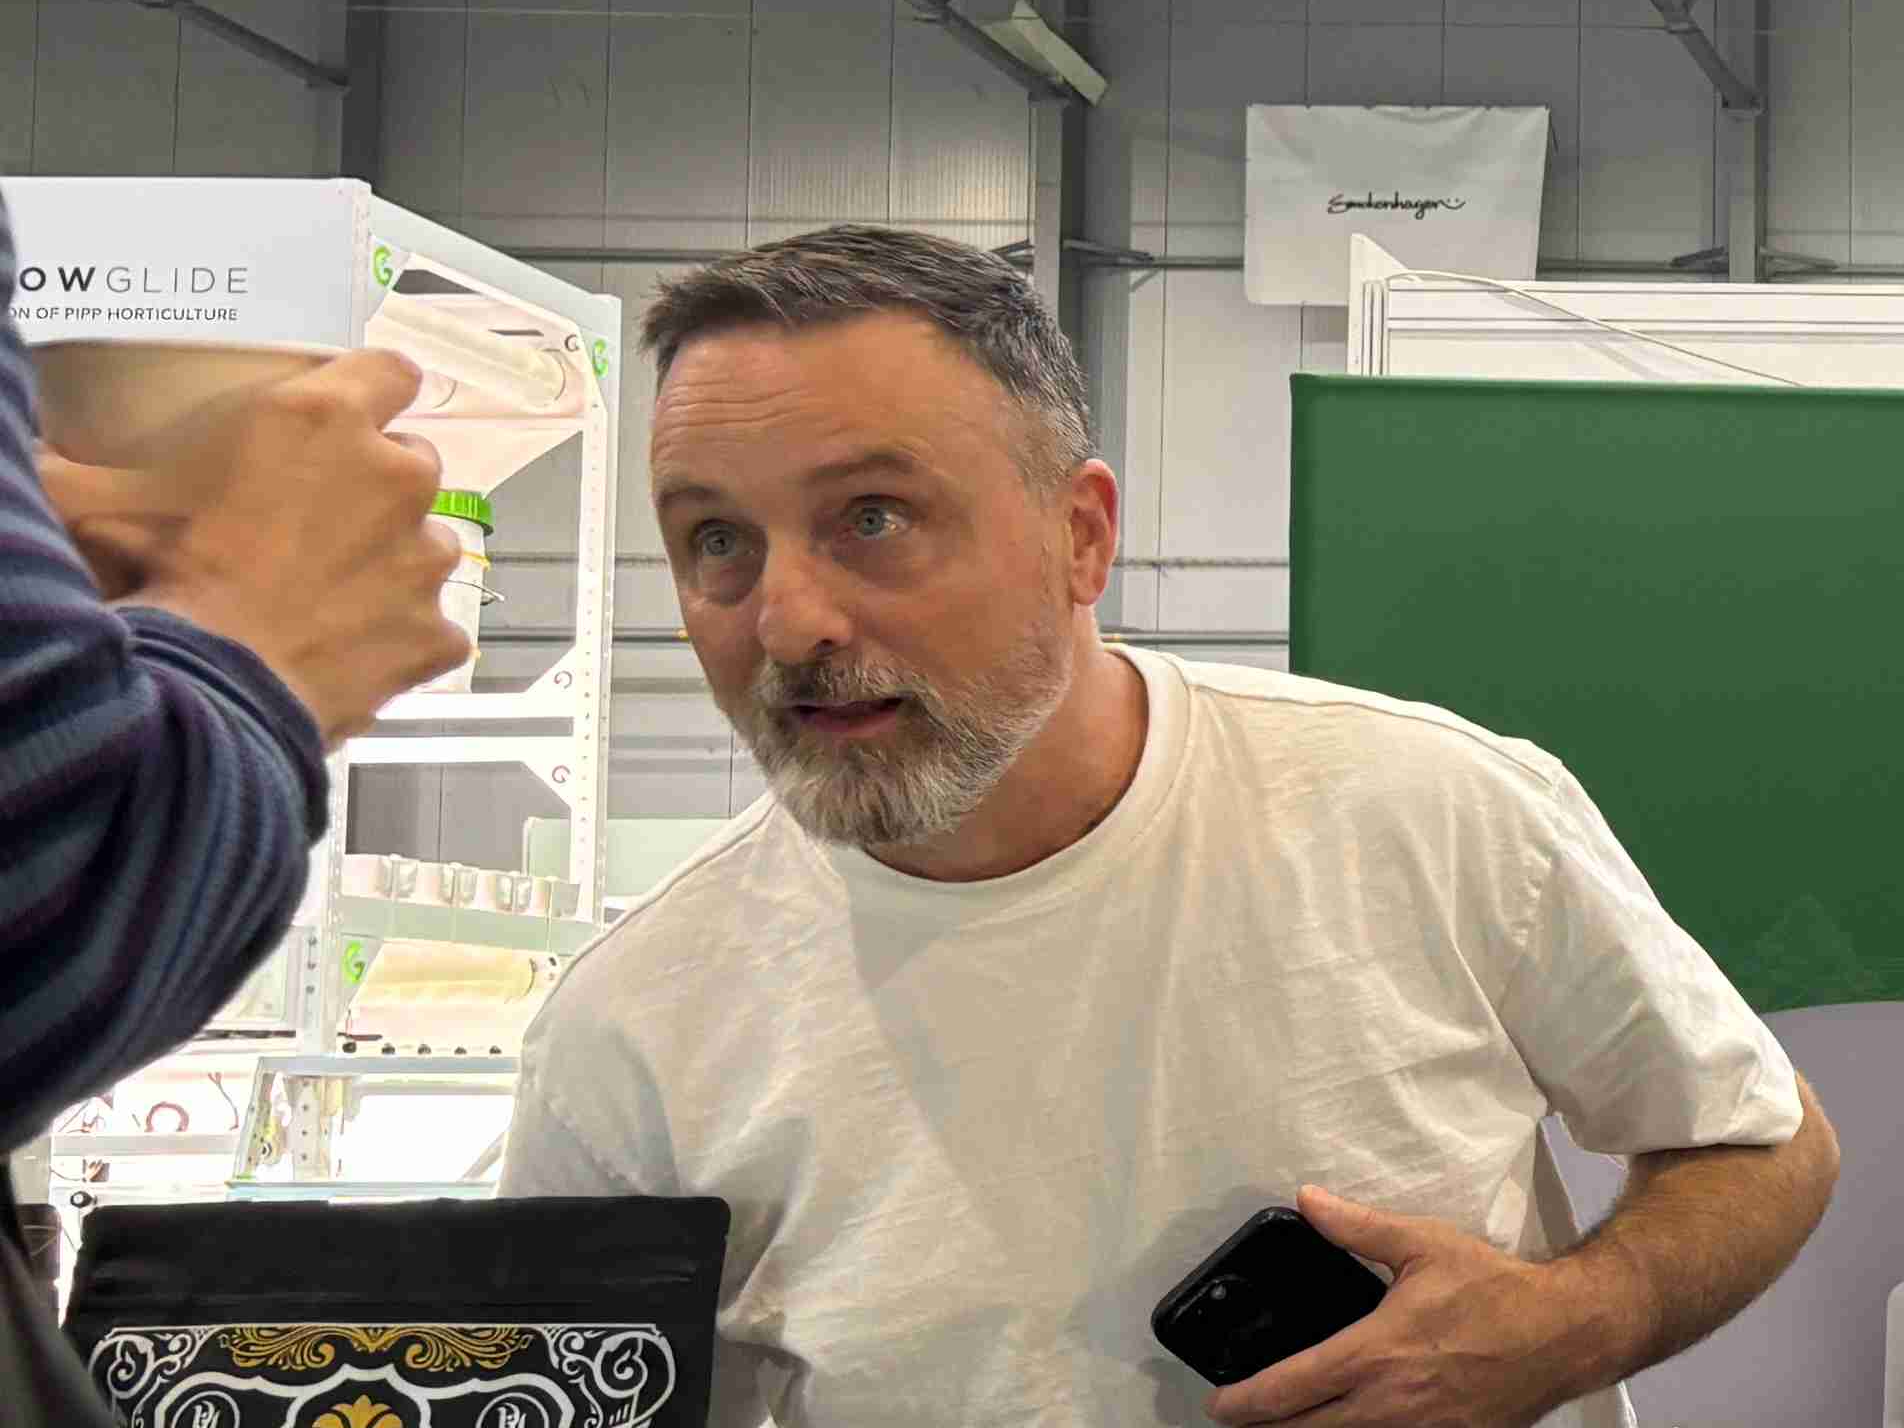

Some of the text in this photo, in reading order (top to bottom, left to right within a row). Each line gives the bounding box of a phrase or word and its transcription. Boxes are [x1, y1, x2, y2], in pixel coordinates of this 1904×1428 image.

[18, 264, 250, 296] OWGLIDE
[38, 306, 60, 321] OF
[65, 305, 102, 322] PIPP
[107, 305, 239, 322] HORTICULTURE
